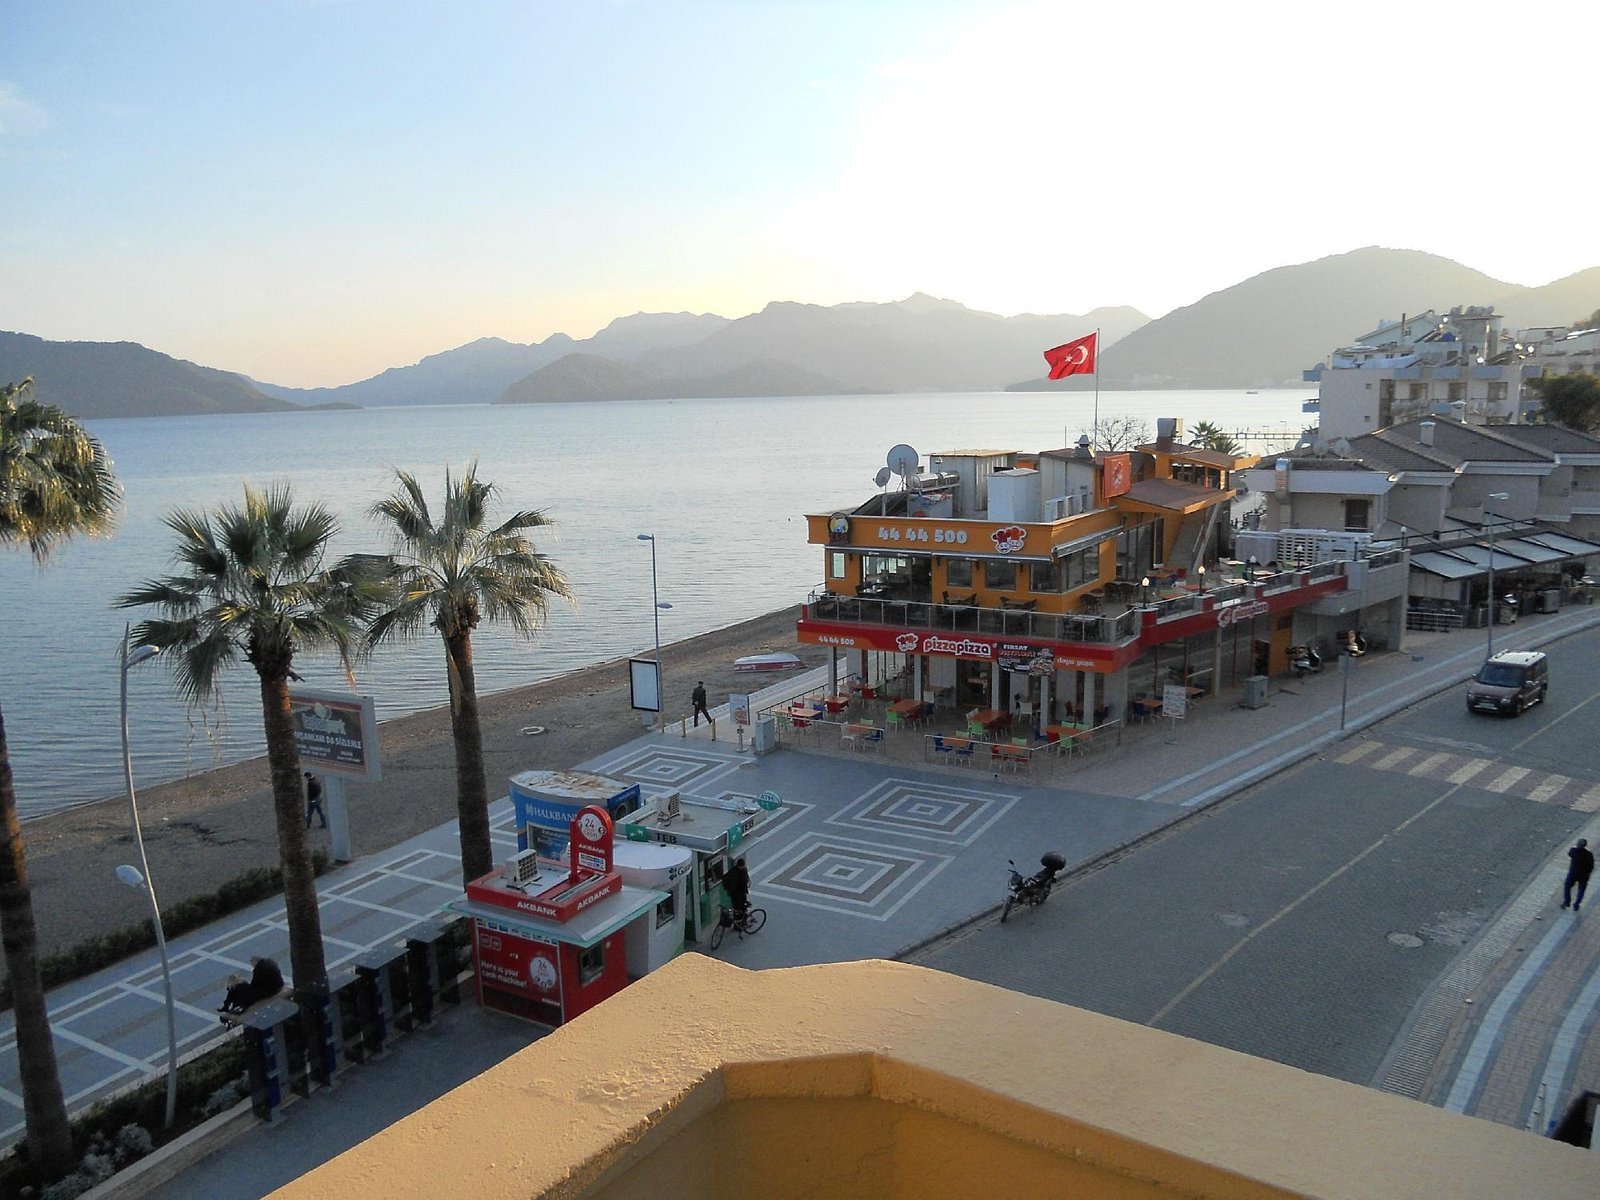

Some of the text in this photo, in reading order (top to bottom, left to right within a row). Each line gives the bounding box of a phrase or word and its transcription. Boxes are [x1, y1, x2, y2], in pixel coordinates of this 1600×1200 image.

[878, 527, 967, 544] 44 44 500
[840, 637, 855, 646] 500
[534, 806, 577, 822] HALKBAN
[585, 818, 595, 828] 24
[655, 832, 677, 845] TEB
[577, 886, 610, 910] AKBANK
[517, 901, 557, 916] AKBANK
